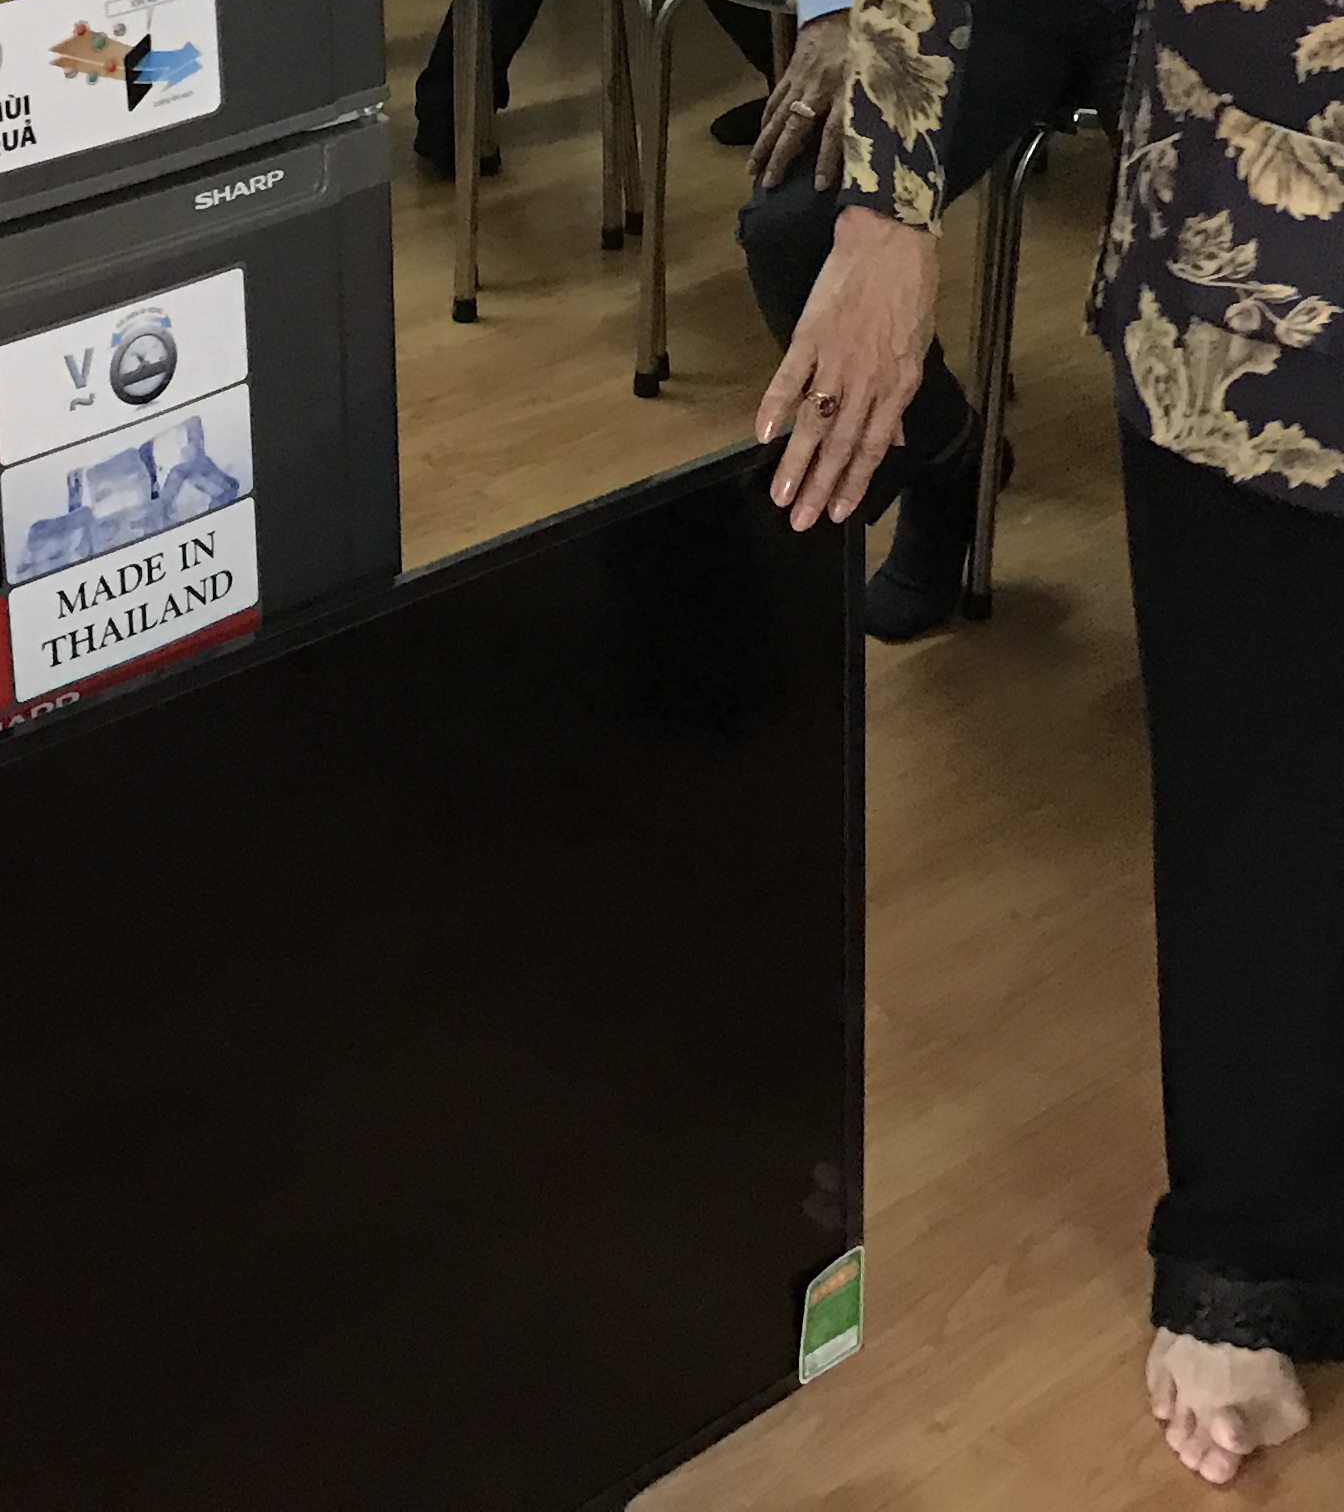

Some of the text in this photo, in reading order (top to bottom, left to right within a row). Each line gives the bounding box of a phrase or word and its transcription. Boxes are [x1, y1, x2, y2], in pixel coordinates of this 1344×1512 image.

[194, 170, 285, 210] SHARP
[41, 569, 233, 668] THAILAND
[56, 530, 216, 620] MADE IN
